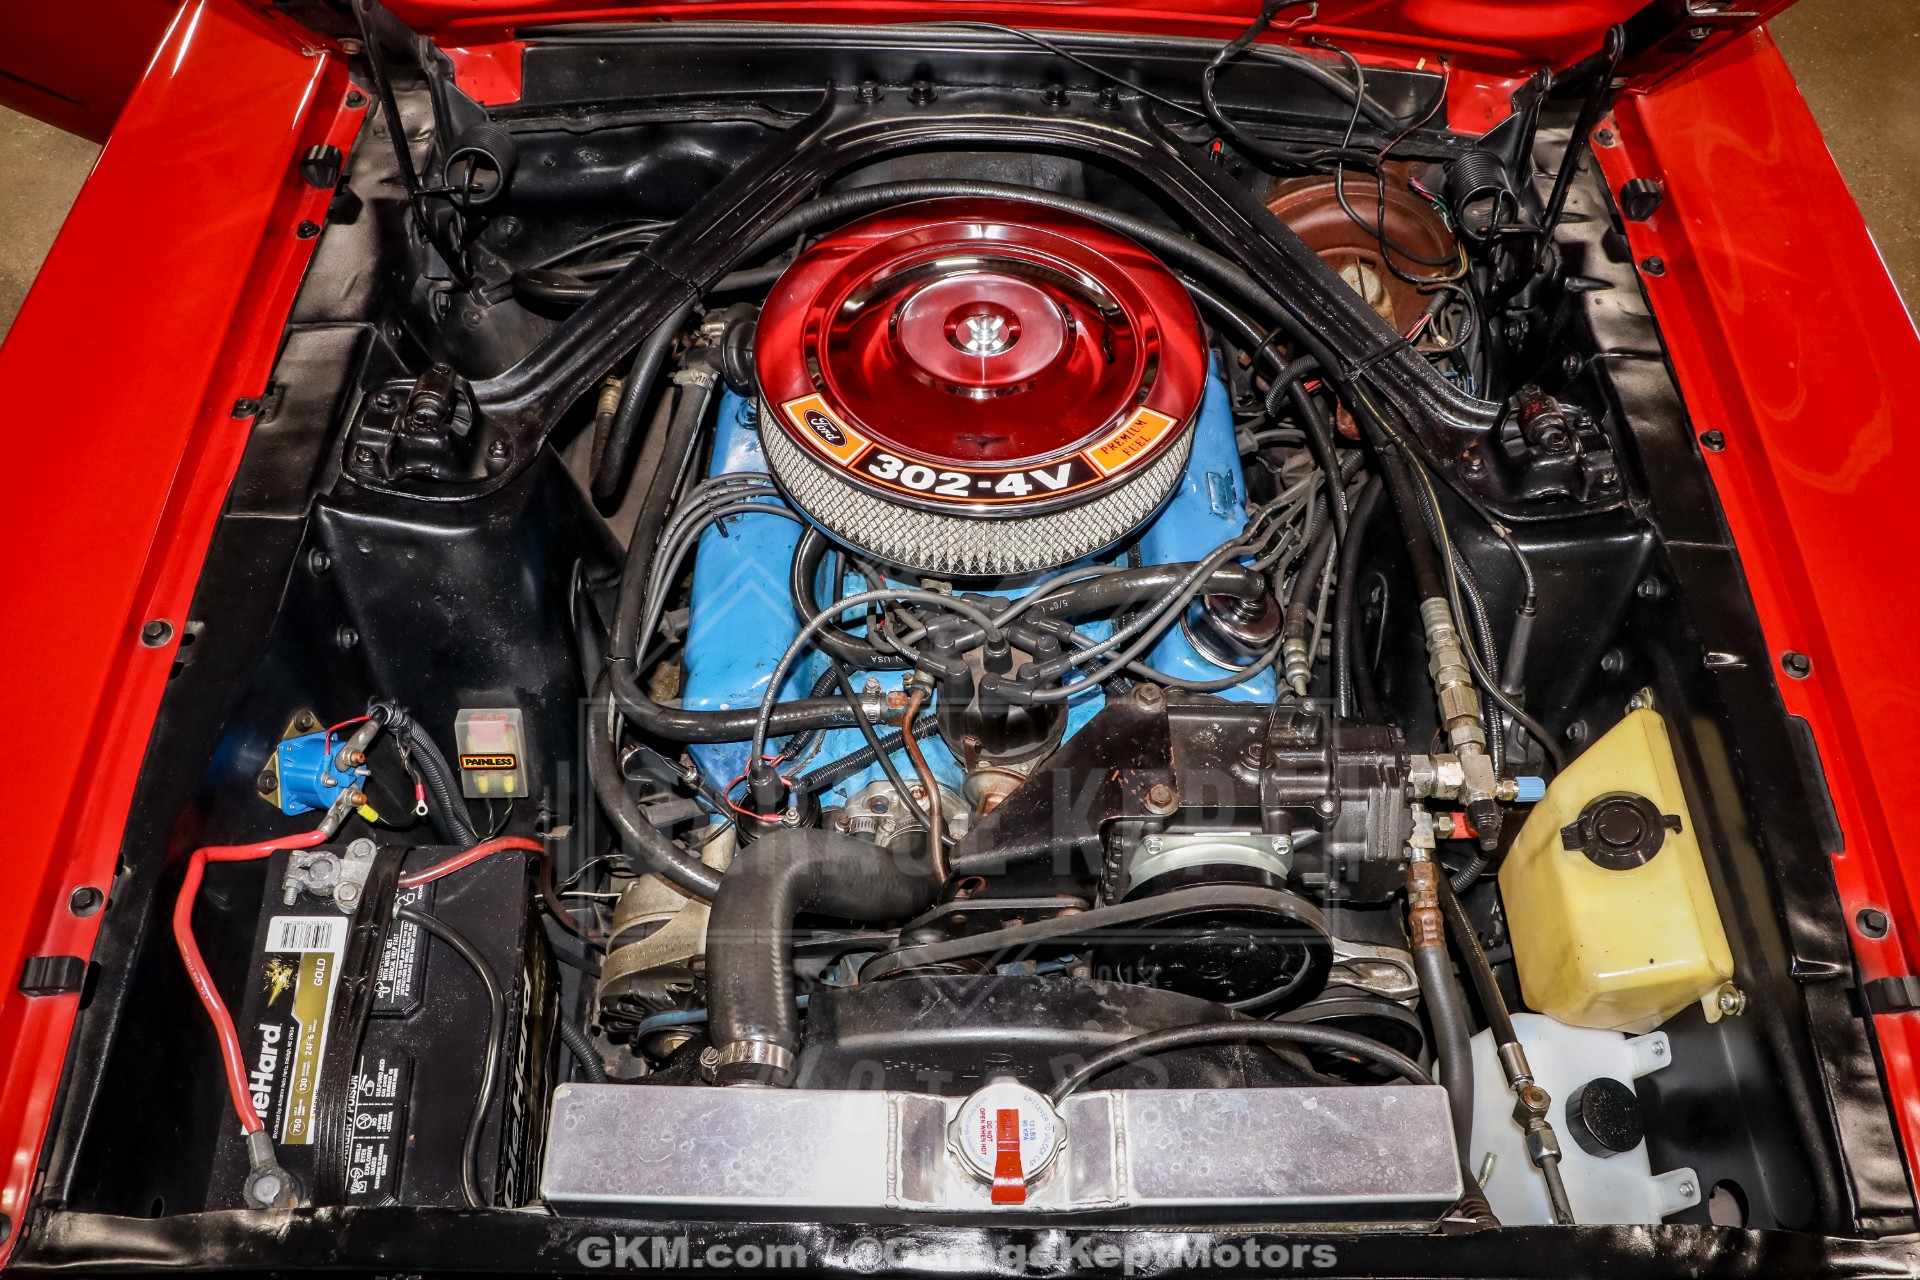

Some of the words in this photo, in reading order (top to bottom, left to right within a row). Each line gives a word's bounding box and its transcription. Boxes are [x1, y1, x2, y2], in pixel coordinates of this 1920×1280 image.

[809, 413, 841, 444] Ford
[1100, 418, 1148, 456] PREMIUM
[1124, 435, 1151, 458] FUEL
[868, 454, 1072, 498] 302-4V
[870, 656, 891, 664] USA
[464, 758, 512, 766] PAINLESS
[314, 958, 326, 986] GOLD
[305, 1034, 314, 1055] 24F-6
[348, 1076, 358, 1112] POISON
[504, 966, 531, 1208] DieHard
[371, 1118, 377, 1126] NO
[1034, 1103, 1049, 1122] LEVER
[293, 1119, 301, 1132] 750
[987, 1120, 992, 1129] DO
[1044, 1121, 1051, 1130] TO
[1039, 1132, 1050, 1156] UNLOCK
[364, 1146, 373, 1176] EXPLOSIVE
[1029, 1156, 1040, 1166] CAP
